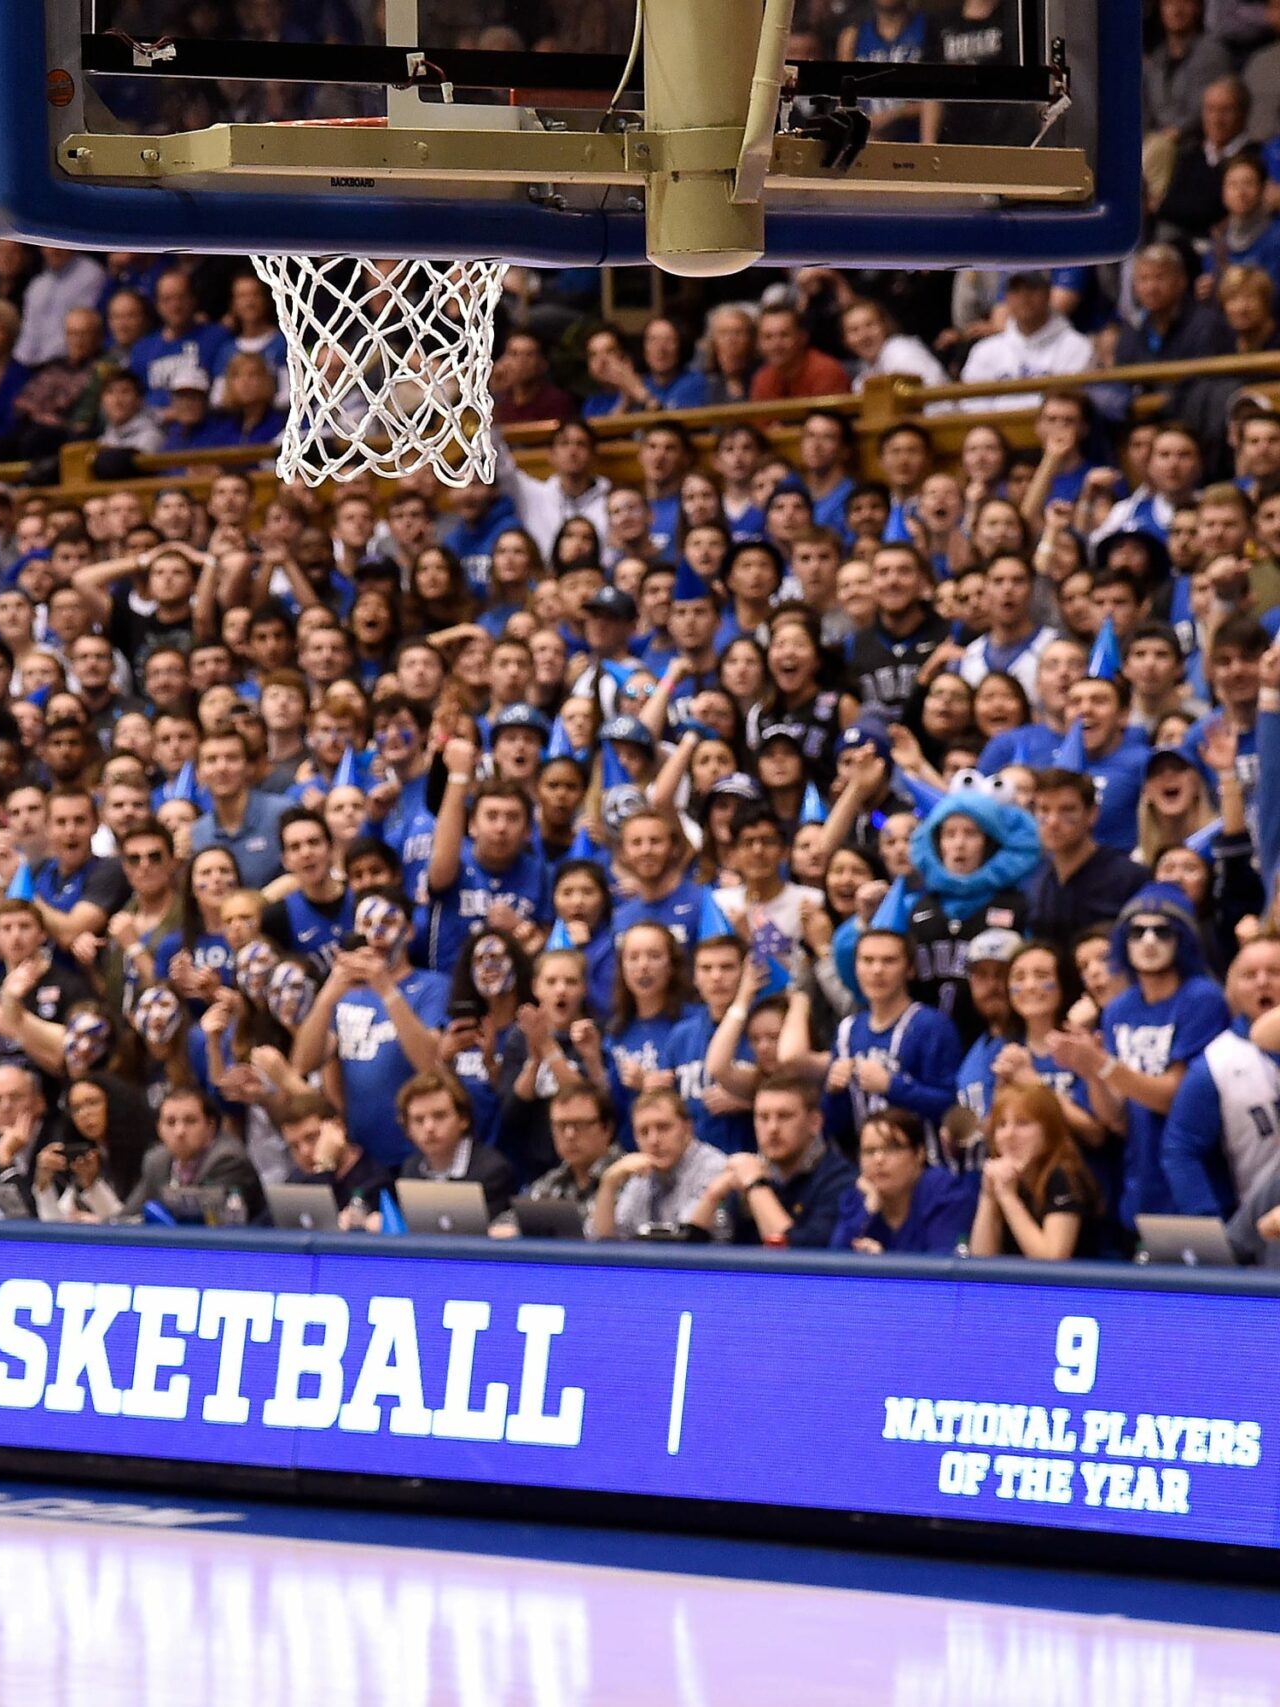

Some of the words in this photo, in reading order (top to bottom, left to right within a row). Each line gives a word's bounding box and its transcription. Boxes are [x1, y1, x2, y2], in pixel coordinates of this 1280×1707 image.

[330, 176, 376, 188] BACKBOARD
[1053, 1315, 1100, 1394] 9
[882, 1396, 1078, 1453] NATIONAL
[1080, 1409, 1262, 1467] PLAYERS
[939, 1450, 992, 1496] OF
[994, 1454, 1075, 1504] THE
[1080, 1460, 1190, 1515] YEAR
